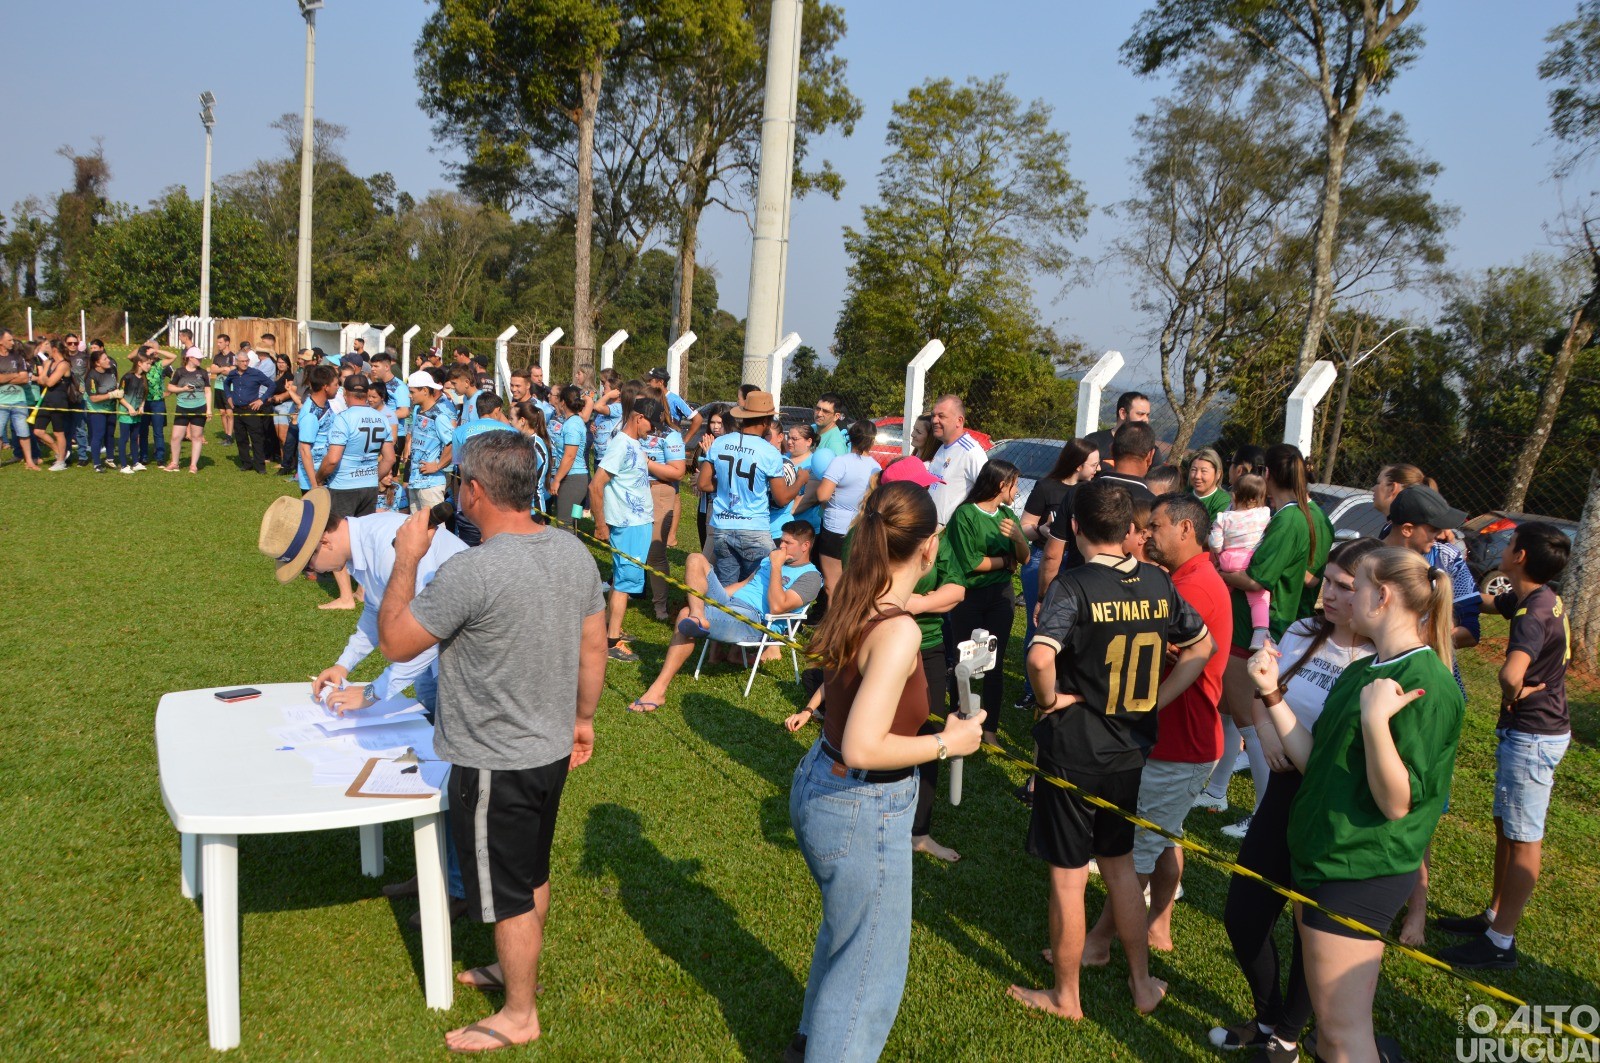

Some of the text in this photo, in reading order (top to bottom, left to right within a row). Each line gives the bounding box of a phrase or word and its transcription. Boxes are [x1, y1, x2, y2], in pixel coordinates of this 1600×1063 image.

[358, 426, 385, 453] 75
[724, 443, 755, 456] BONATTI
[718, 455, 757, 492] 74
[1092, 598, 1169, 622] NEYMAR JR
[1104, 631, 1162, 715] 10
[1312, 657, 1344, 674] NEVER STO
